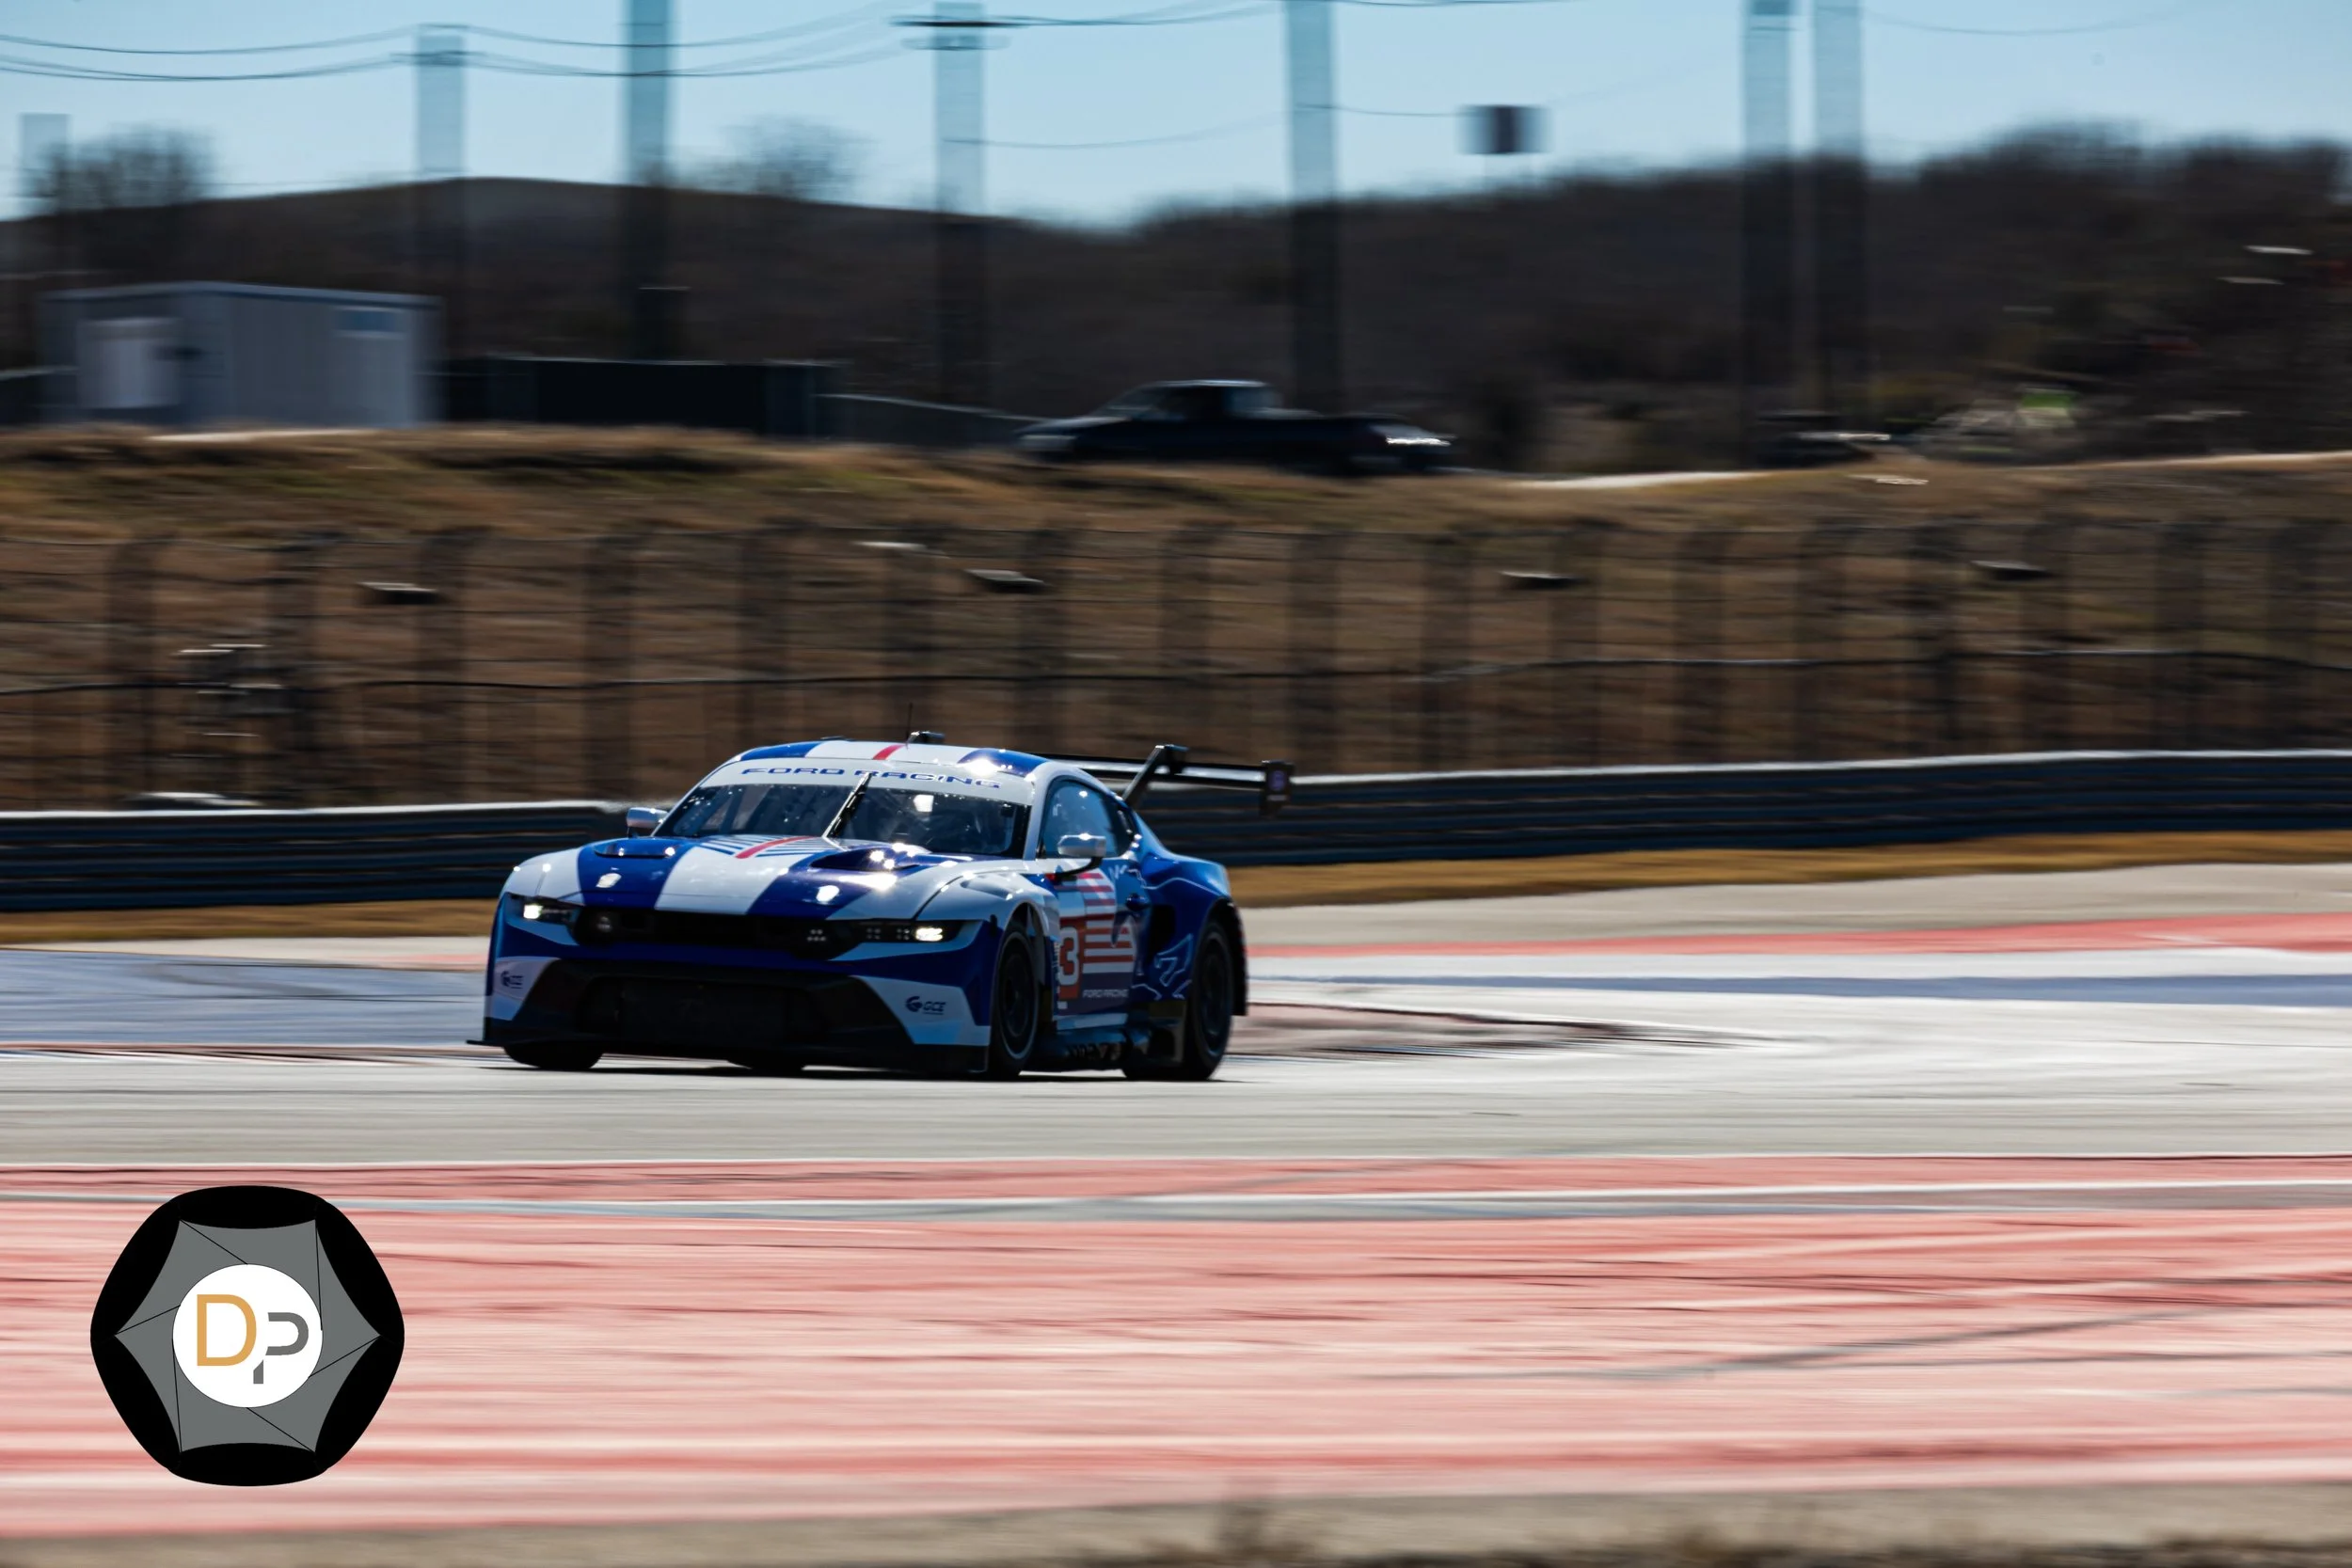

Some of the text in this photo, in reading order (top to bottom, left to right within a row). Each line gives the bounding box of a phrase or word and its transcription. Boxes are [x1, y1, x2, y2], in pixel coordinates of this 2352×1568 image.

[741, 767, 1001, 789] FORD RACING
[1058, 927, 1080, 986] 3
